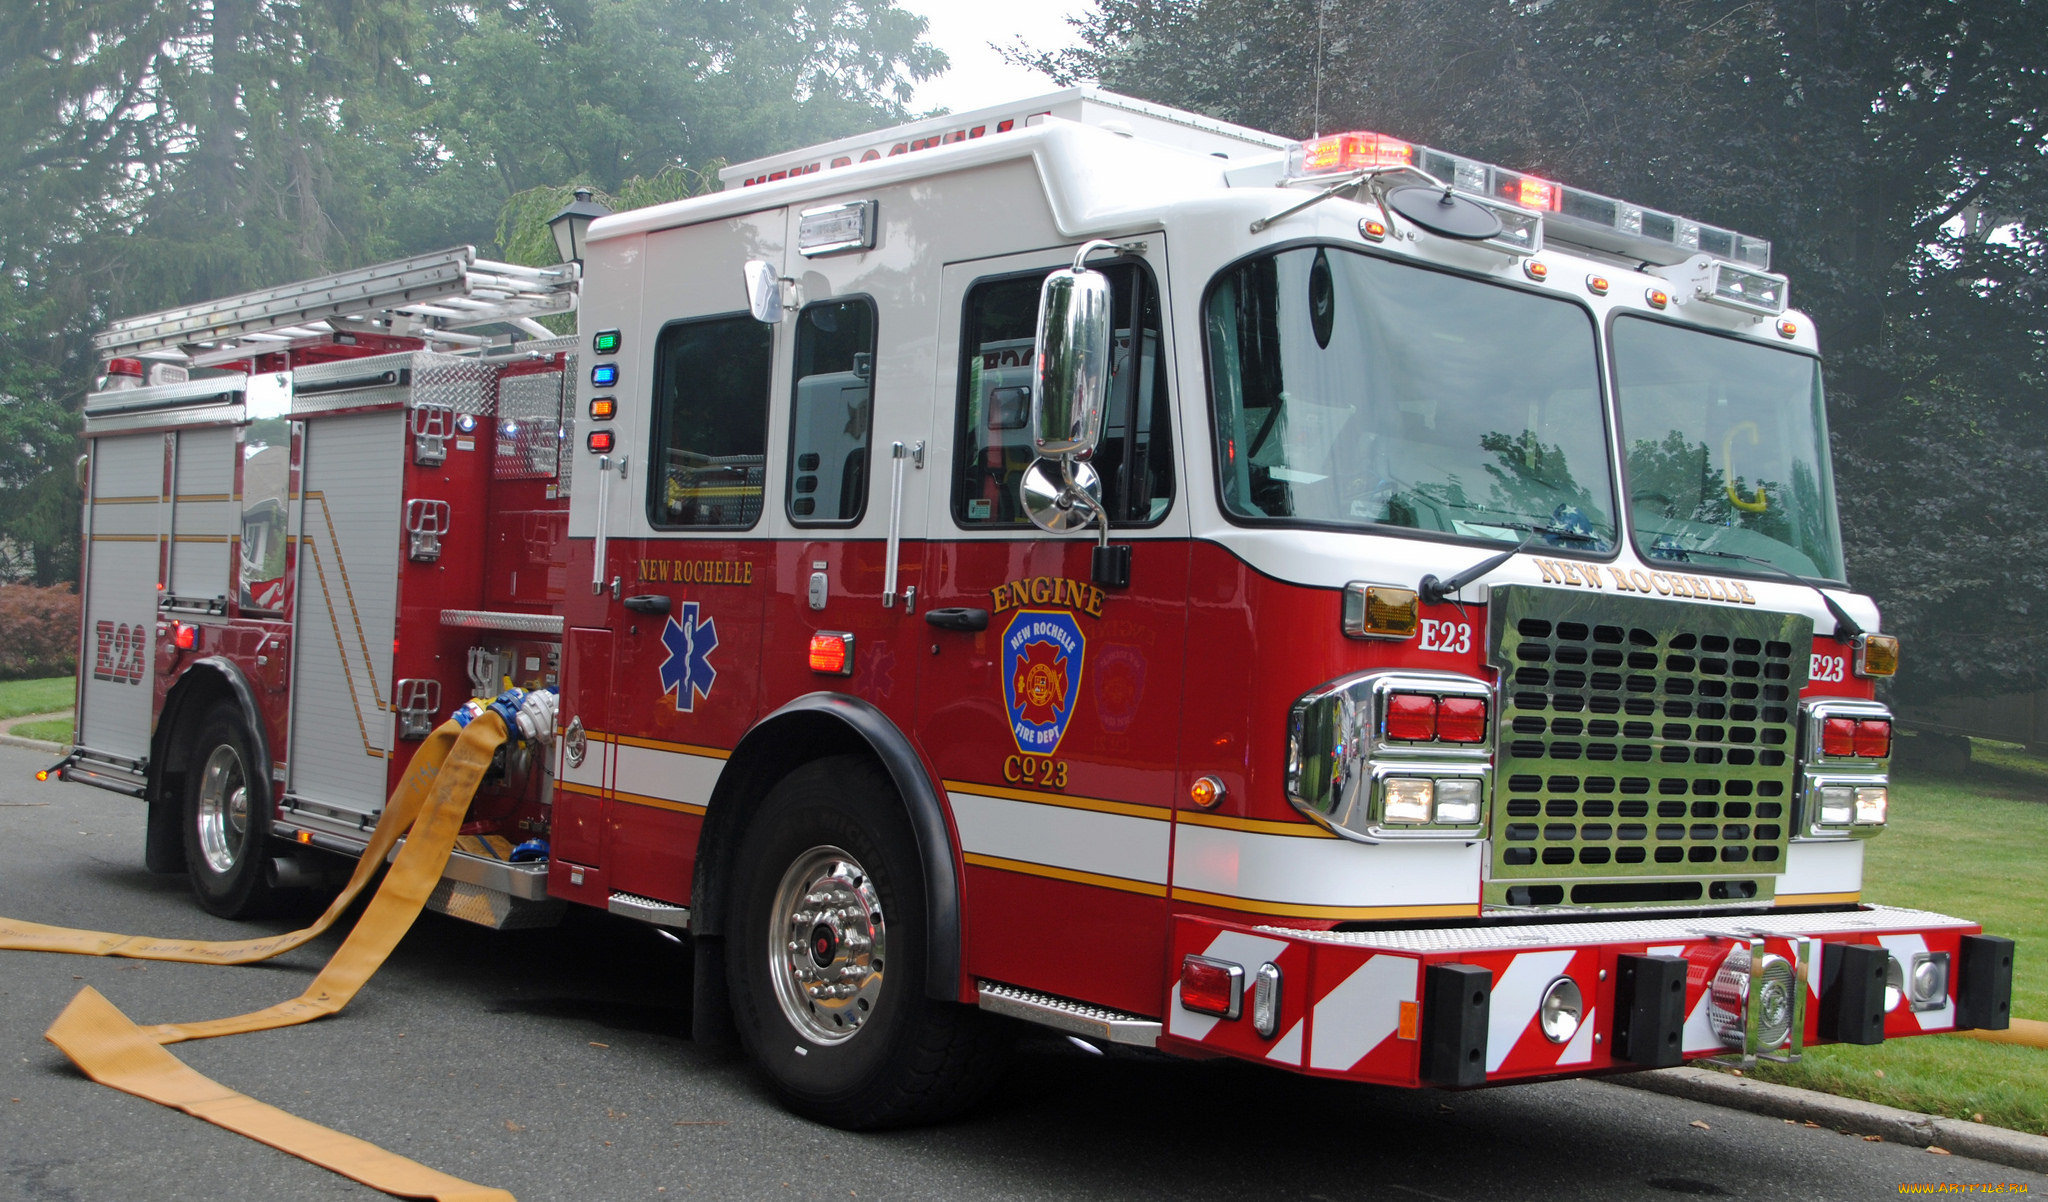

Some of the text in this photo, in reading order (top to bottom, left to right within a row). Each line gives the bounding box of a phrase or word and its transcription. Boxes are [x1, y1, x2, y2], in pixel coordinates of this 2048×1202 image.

[638, 559, 753, 585] NEW ROCHELLE
[1533, 558, 1757, 605] NEW ROCHELLE
[990, 576, 1106, 619] ENGINE
[1010, 625, 1031, 650] NEW
[1033, 621, 1076, 654] ROCHELLE
[1418, 618, 1471, 654] E23
[1808, 653, 1845, 683] E23
[1015, 722, 1061, 745] FIRE DEPT
[1040, 759, 1069, 788] 23
